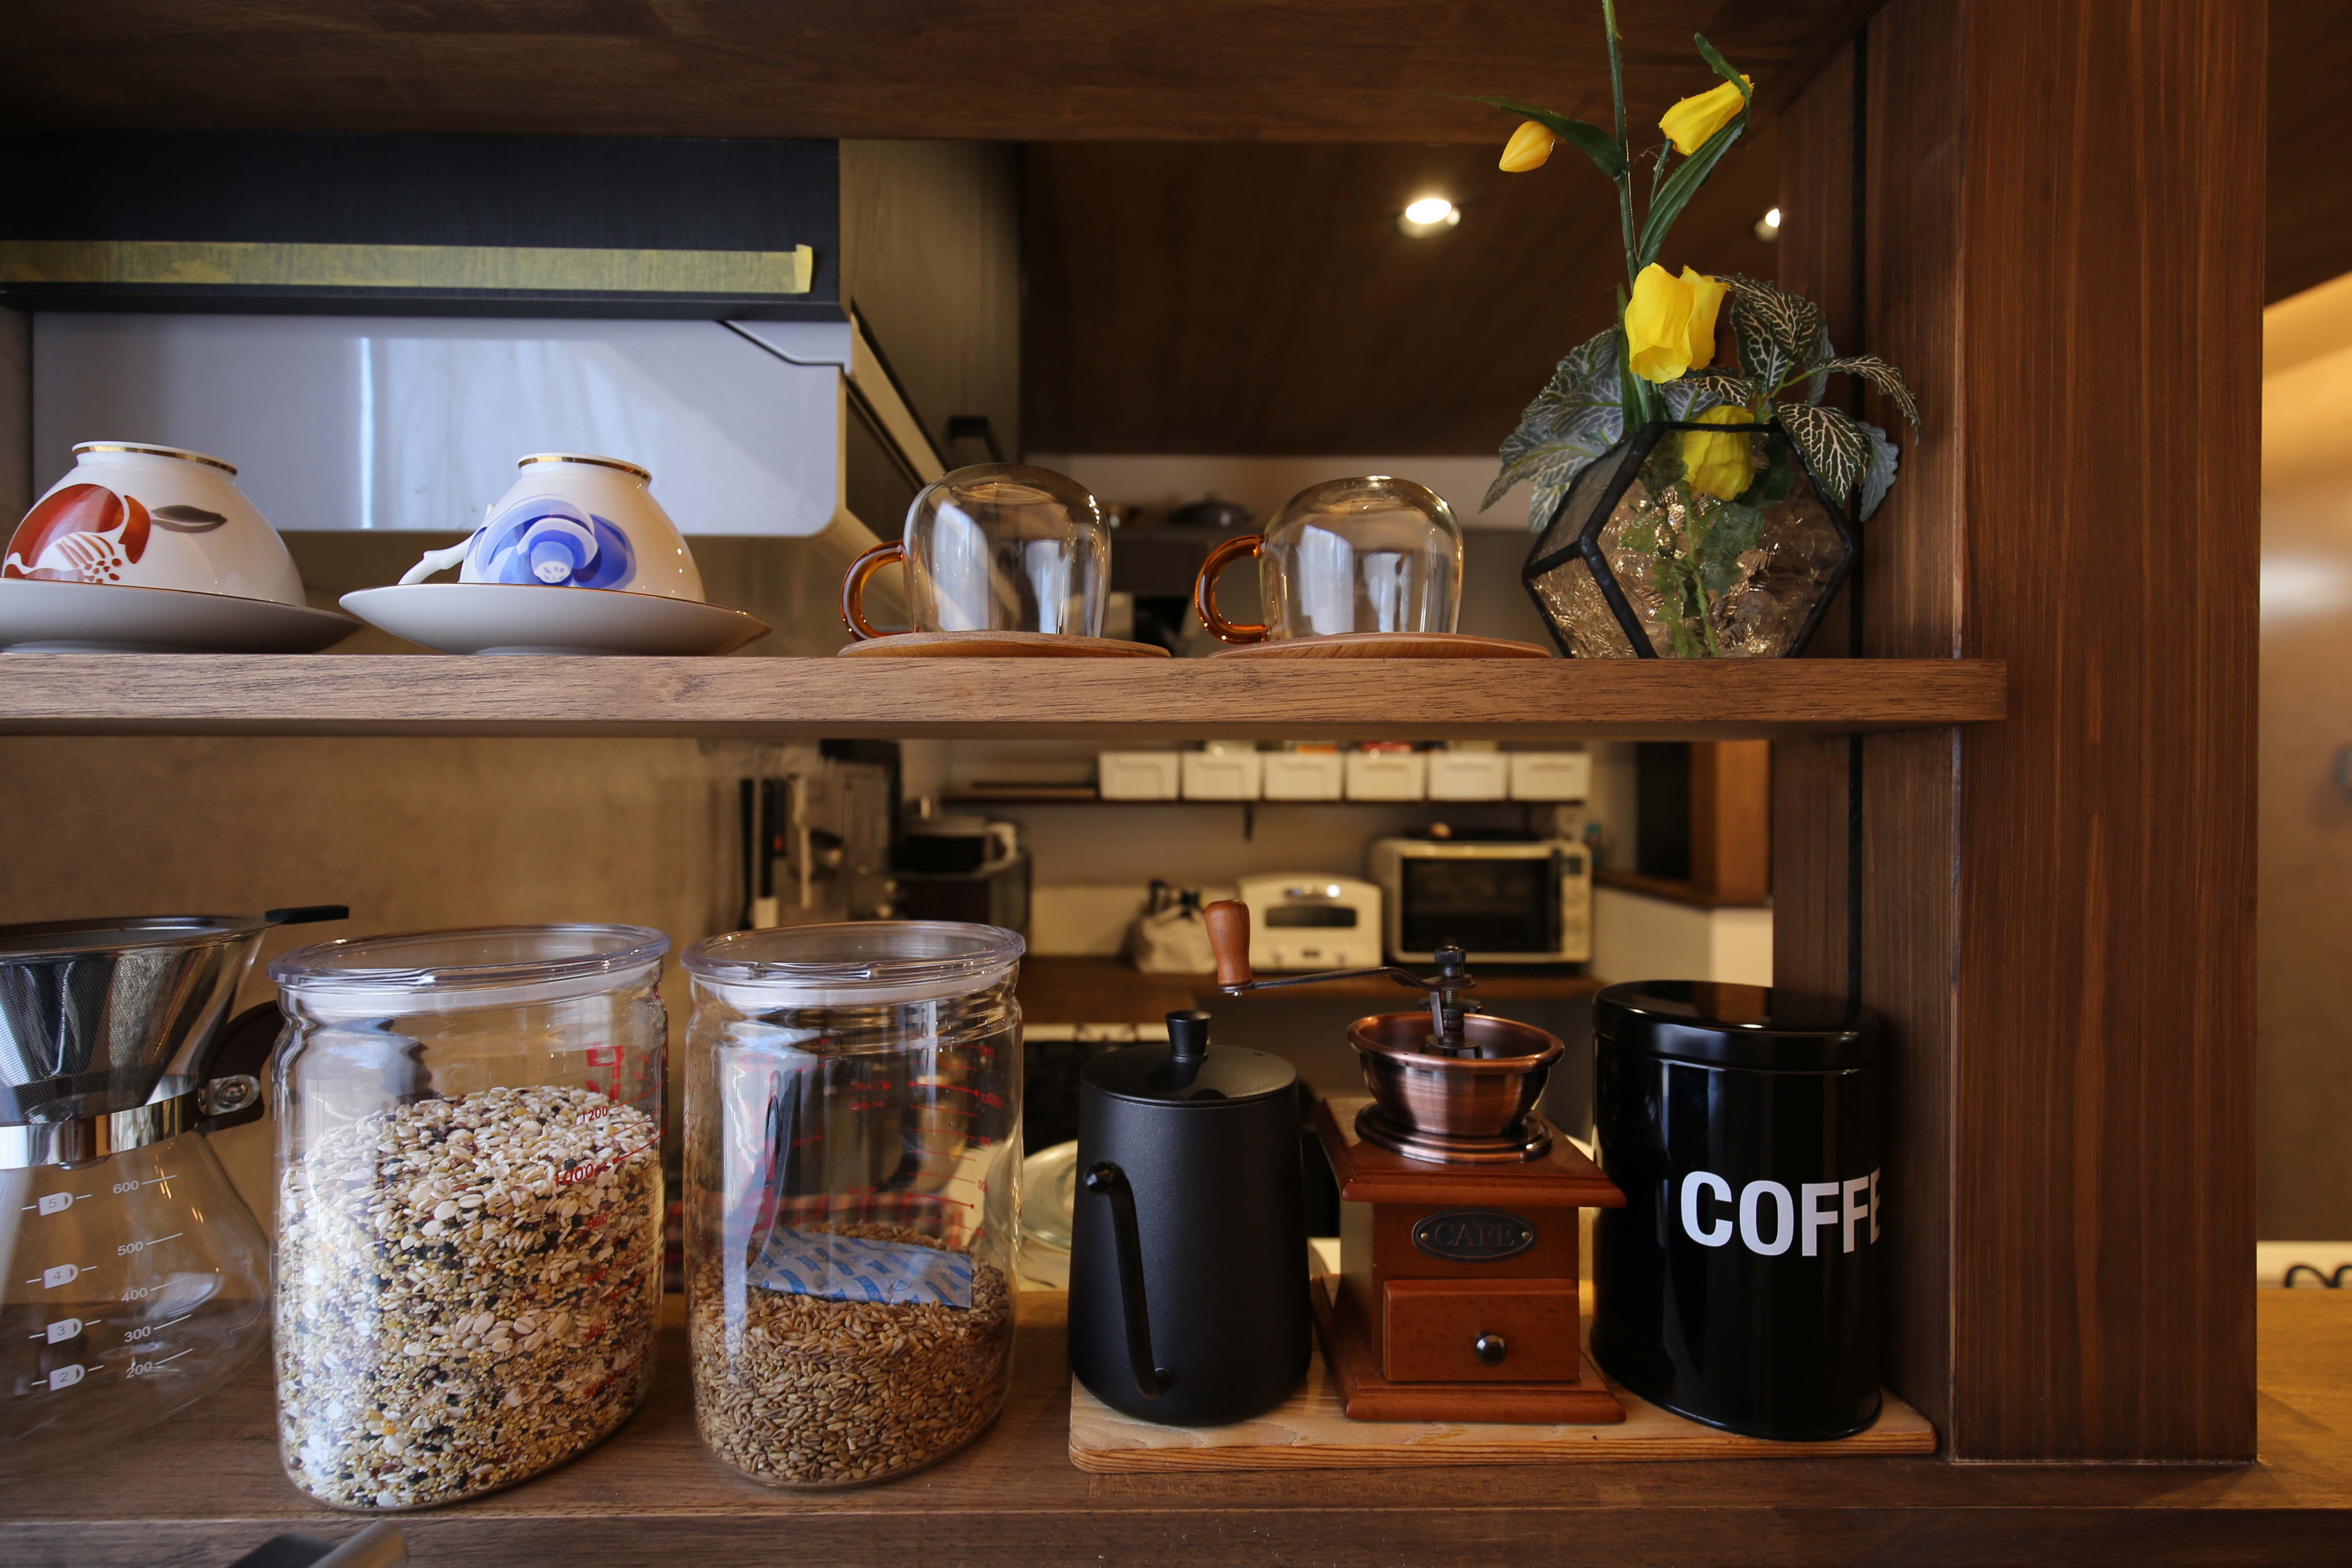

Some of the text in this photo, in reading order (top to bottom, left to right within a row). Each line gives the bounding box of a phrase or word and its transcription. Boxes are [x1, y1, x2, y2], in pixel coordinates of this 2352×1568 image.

[582, 1106, 608, 1122] 1200
[554, 1162, 610, 1187] 1000cc
[113, 1180, 139, 1194] 600
[48, 1198, 57, 1208] 5
[588, 1213, 608, 1230] 800
[1435, 1223, 1515, 1247] CAFE
[117, 1242, 144, 1256] 500
[53, 1271, 61, 1280] 4
[121, 1288, 148, 1303] 400
[57, 1326, 65, 1336] 3
[124, 1327, 151, 1343] 300
[60, 1371, 68, 1382] 2
[126, 1361, 153, 1379] 200
